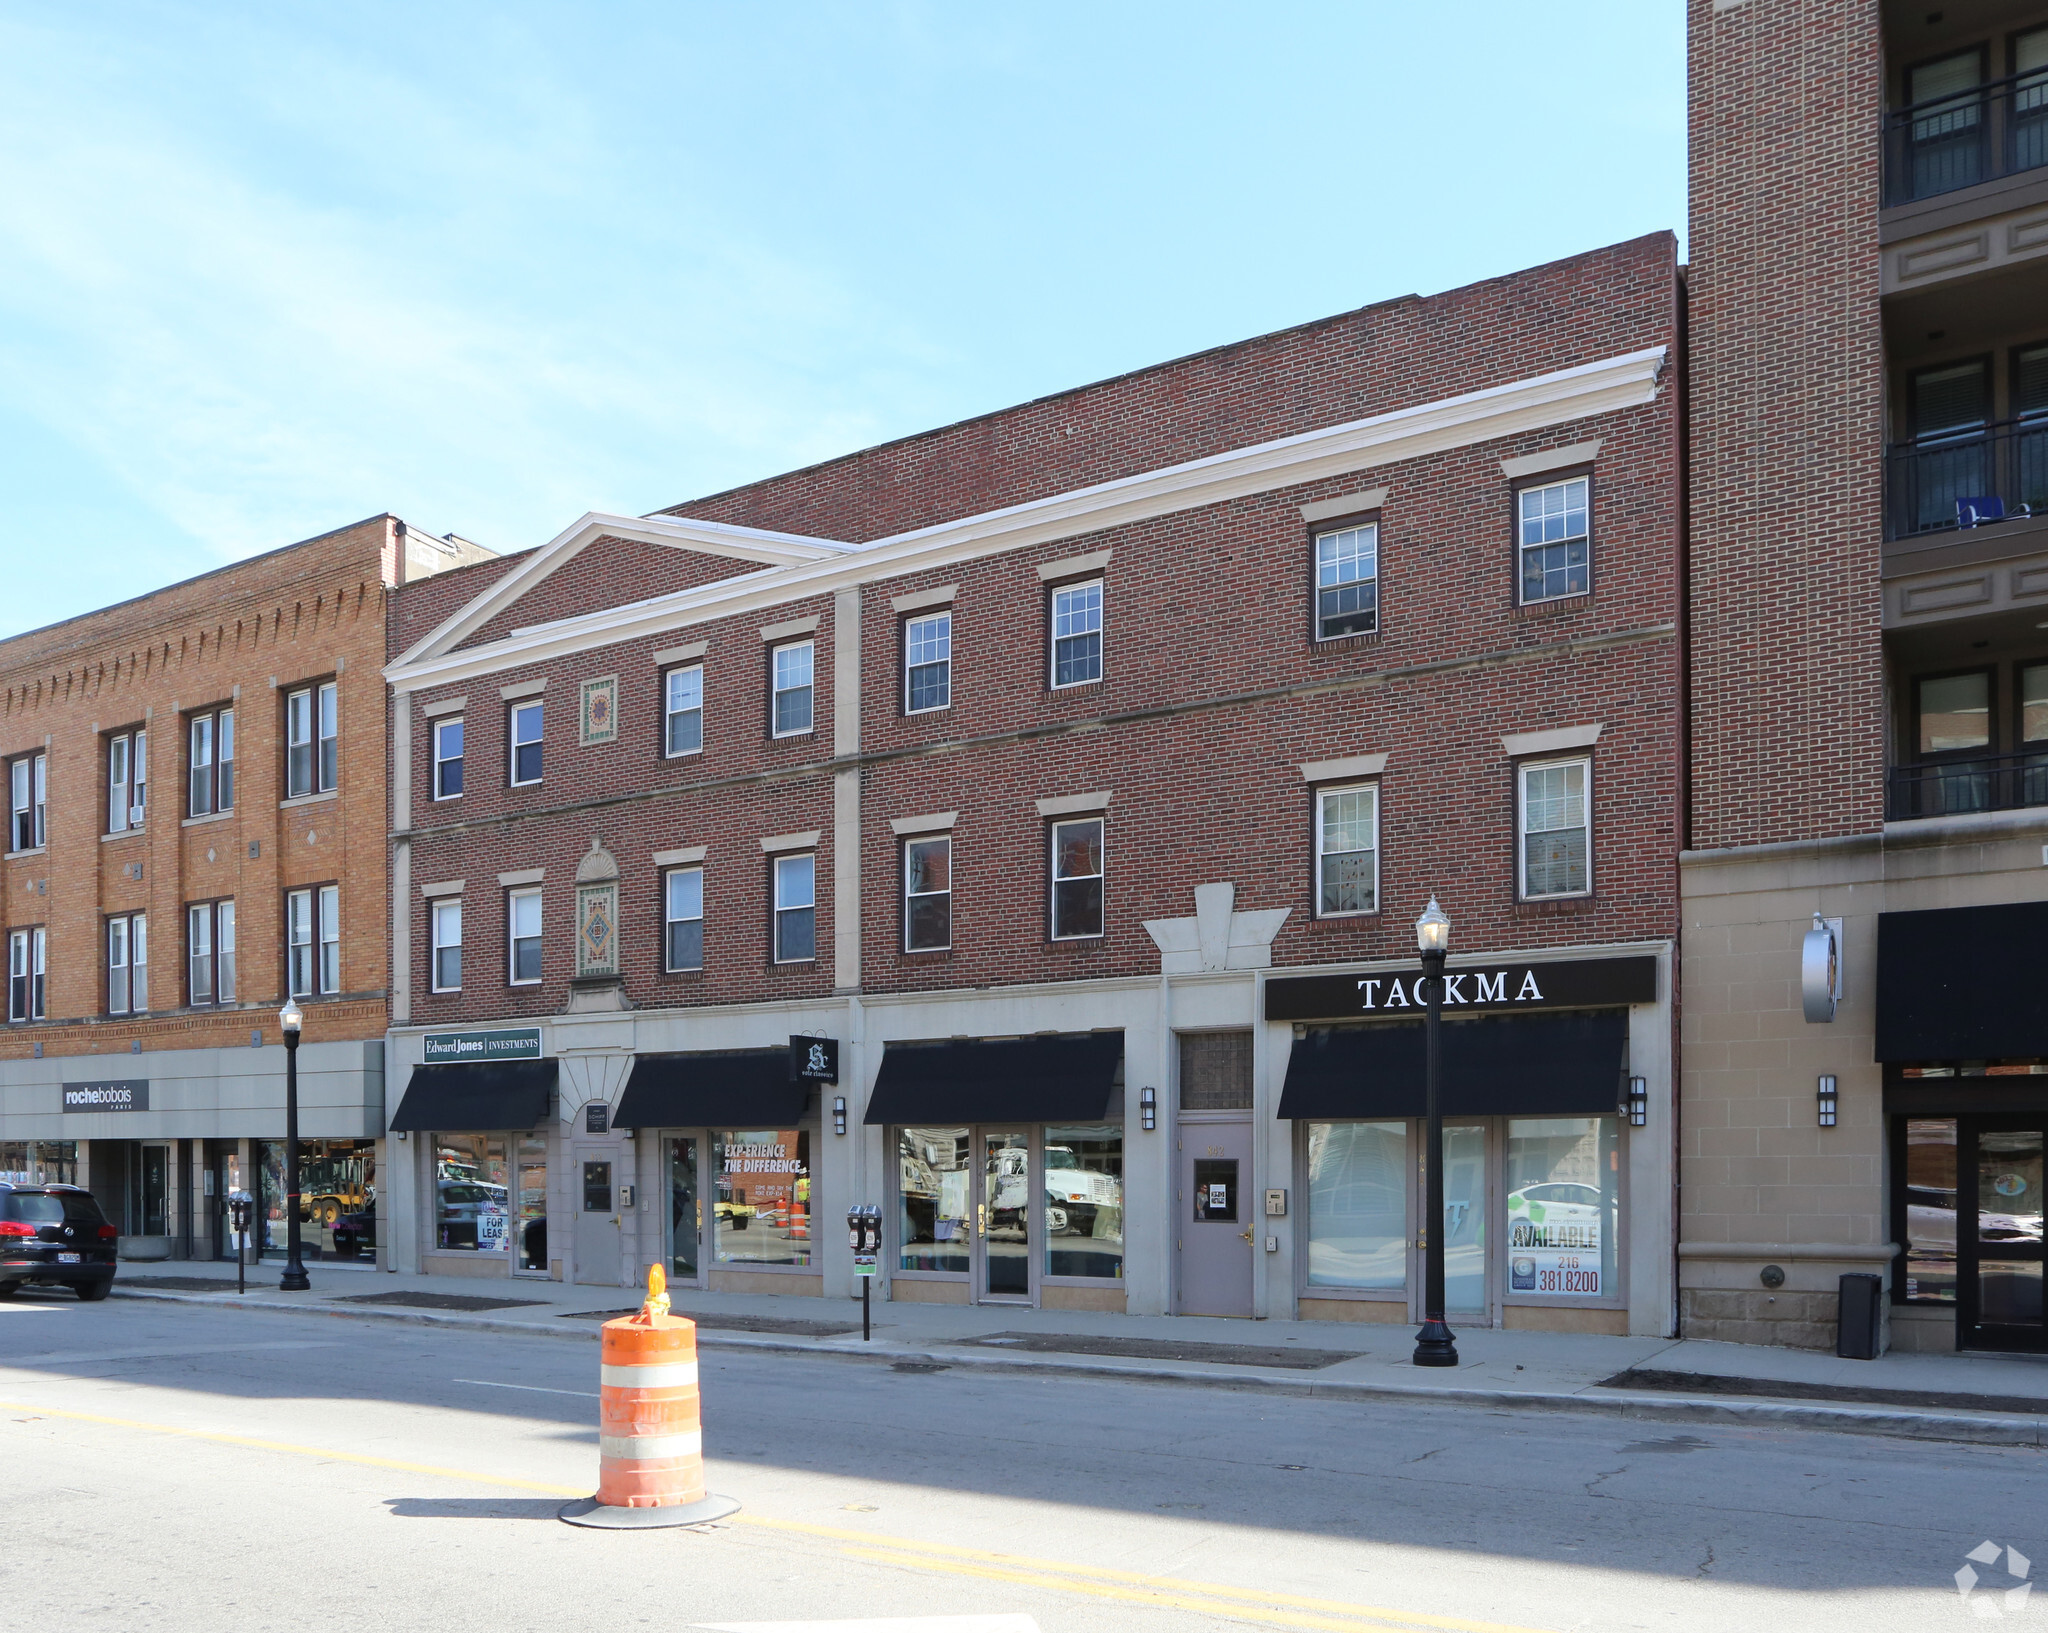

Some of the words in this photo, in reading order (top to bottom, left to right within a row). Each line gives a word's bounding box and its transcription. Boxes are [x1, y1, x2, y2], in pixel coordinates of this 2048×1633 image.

[1358, 969, 1544, 1009] TACKMA
[488, 1038, 538, 1050] INVESTMENTS
[66, 1085, 132, 1104] rochebobois
[724, 1144, 787, 1158] EXP-ERIENCE
[724, 1159, 742, 1173] THE
[743, 1159, 802, 1173] DIFFERENCE
[486, 1217, 503, 1228] FOR
[1512, 1225, 1598, 1248] AVAILABLE
[1558, 1256, 1579, 1269] 216
[1539, 1270, 1598, 1293] 381.8200
